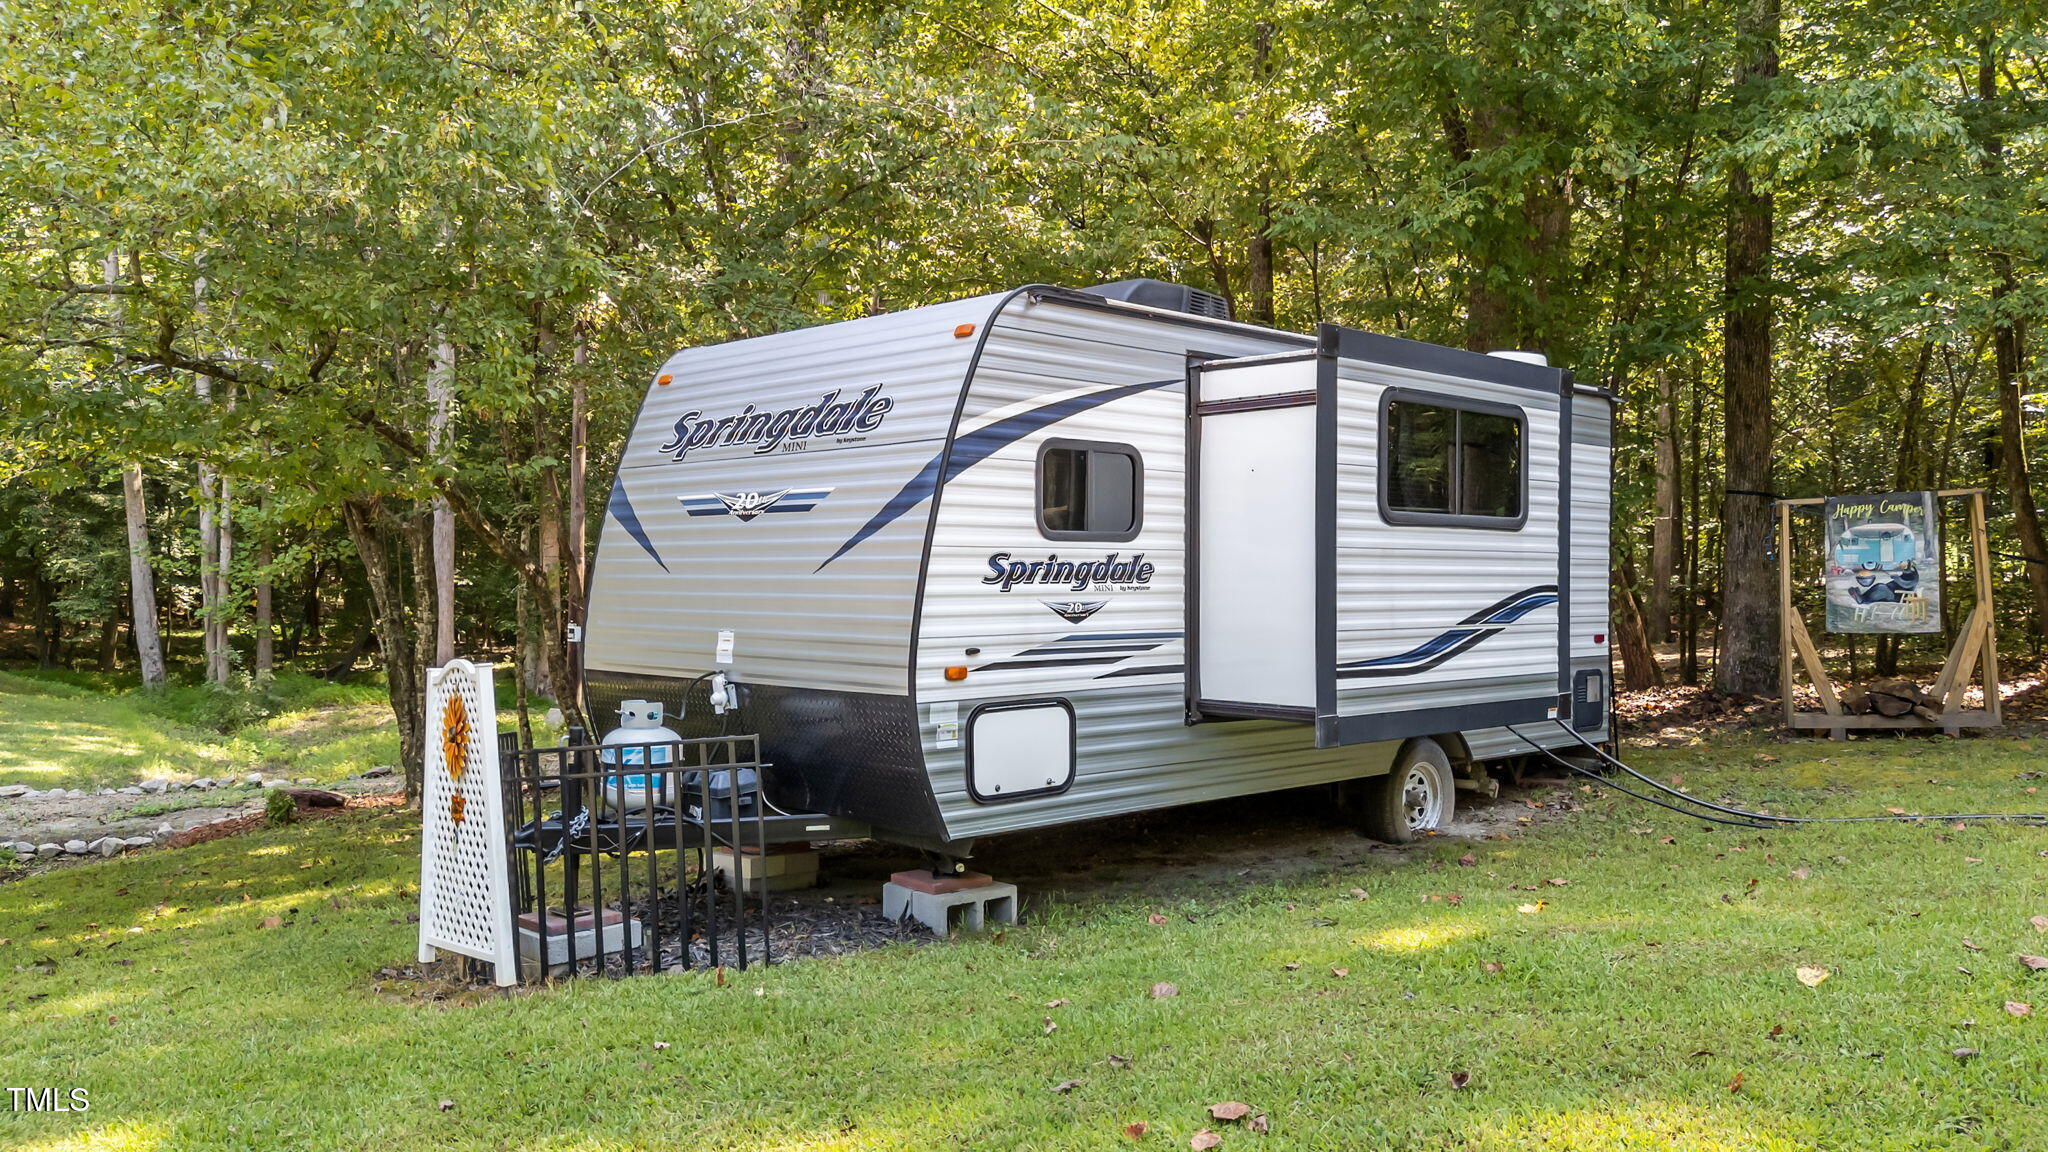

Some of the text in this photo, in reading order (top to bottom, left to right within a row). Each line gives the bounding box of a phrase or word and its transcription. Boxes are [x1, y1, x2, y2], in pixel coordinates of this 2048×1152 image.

[659, 383, 893, 461] Springdale
[782, 441, 807, 452] MINI
[1832, 500, 1924, 519] Happy Camper
[981, 552, 1155, 592] Springdale
